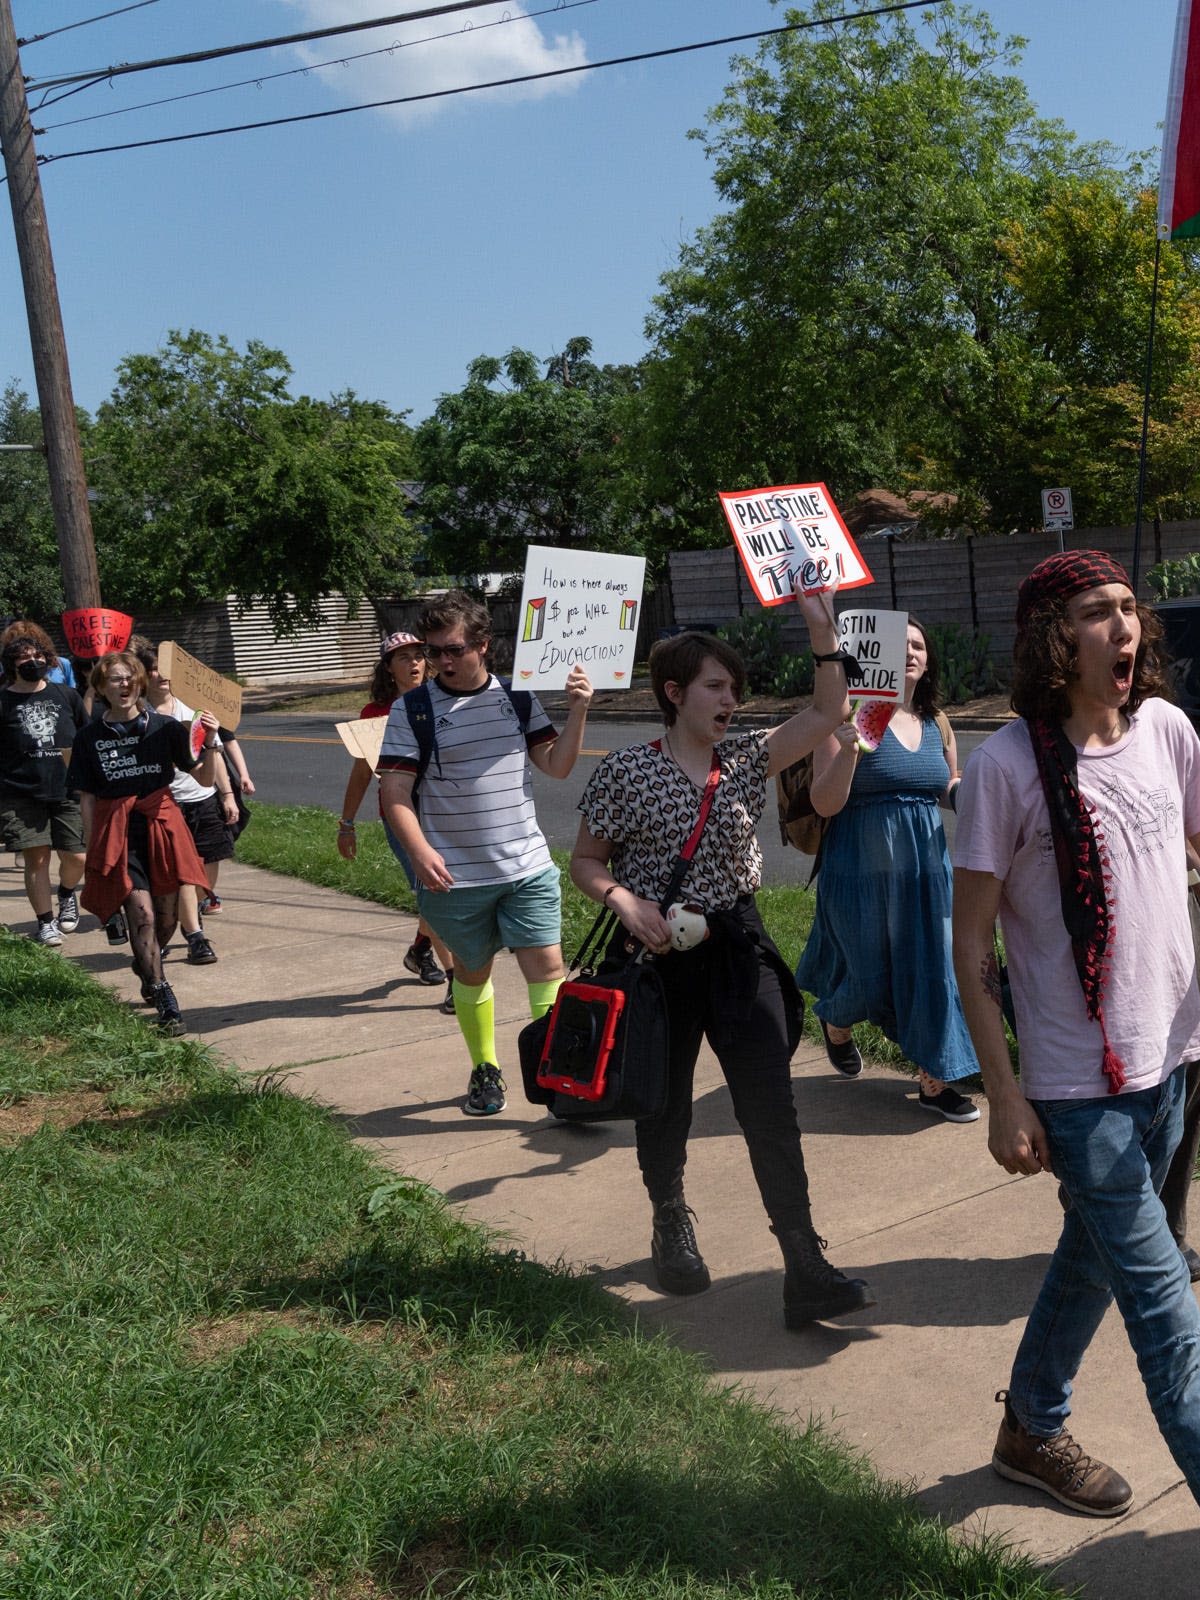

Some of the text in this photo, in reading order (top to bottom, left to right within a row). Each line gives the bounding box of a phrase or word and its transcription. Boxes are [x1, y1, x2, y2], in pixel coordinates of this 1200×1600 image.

[735, 495, 823, 525] PALESTINE
[746, 526, 826, 557] WILL BE
[543, 567, 628, 595] How is there always
[547, 600, 561, 622] $
[585, 603, 609, 619] WAR
[72, 616, 112, 633] FREE
[562, 626, 587, 638] but not
[840, 615, 876, 635] STIN
[71, 633, 125, 650] PALESTINE
[857, 640, 881, 660] NO
[95, 735, 140, 751] Gender
[110, 749, 118, 758] a
